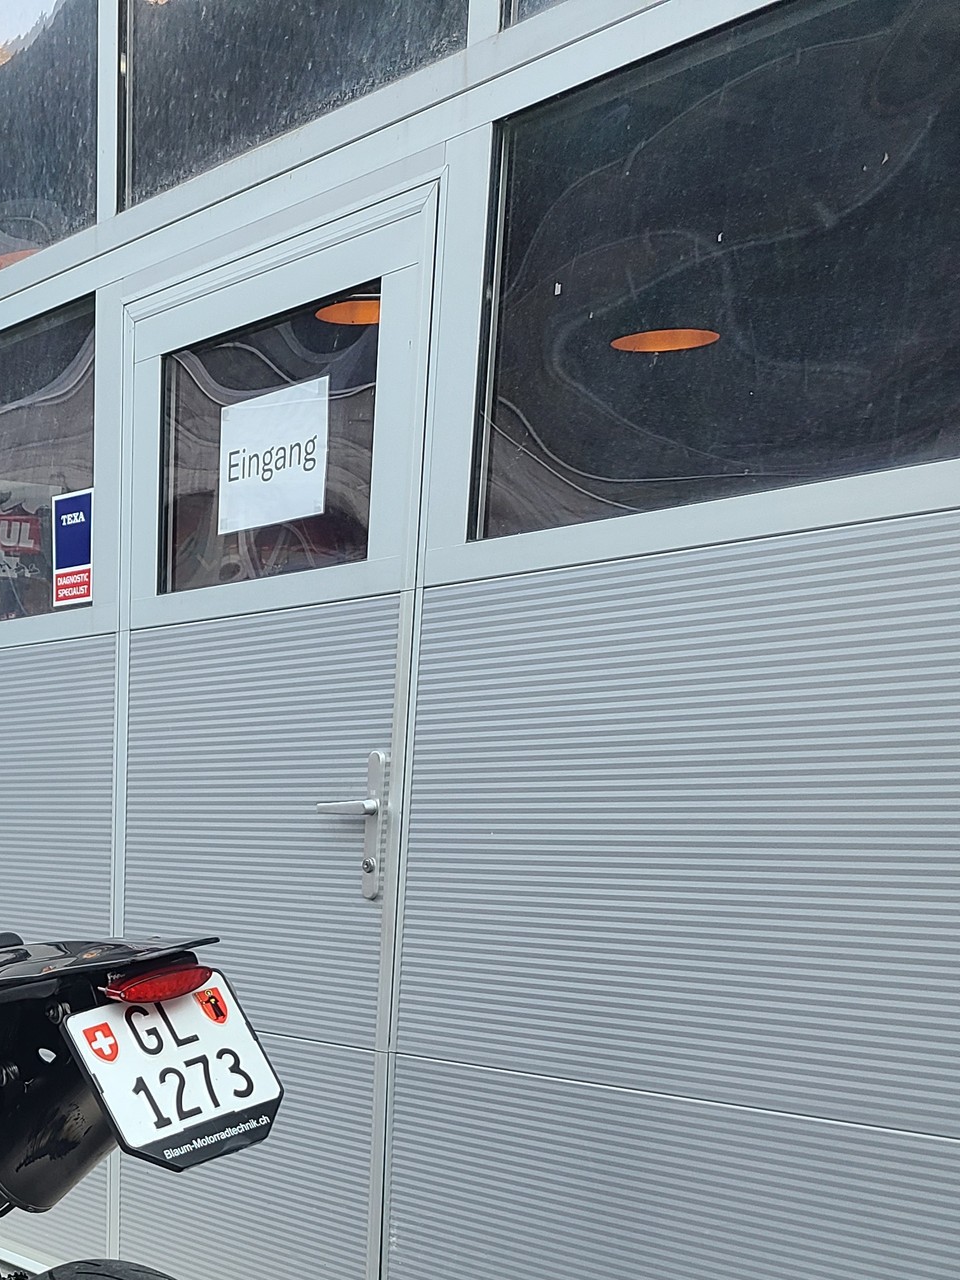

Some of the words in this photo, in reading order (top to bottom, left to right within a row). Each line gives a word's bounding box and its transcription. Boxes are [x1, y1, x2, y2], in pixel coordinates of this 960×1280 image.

[228, 434, 318, 482] Eingang
[60, 511, 86, 526] TEXA
[57, 572, 89, 587] DIAGNOSTIC
[57, 585, 89, 598] SPECIALIST
[124, 1001, 200, 1056] GL
[131, 1047, 255, 1130] 1273
[162, 1114, 271, 1160] Blaum-Motorradtechnik.ch
